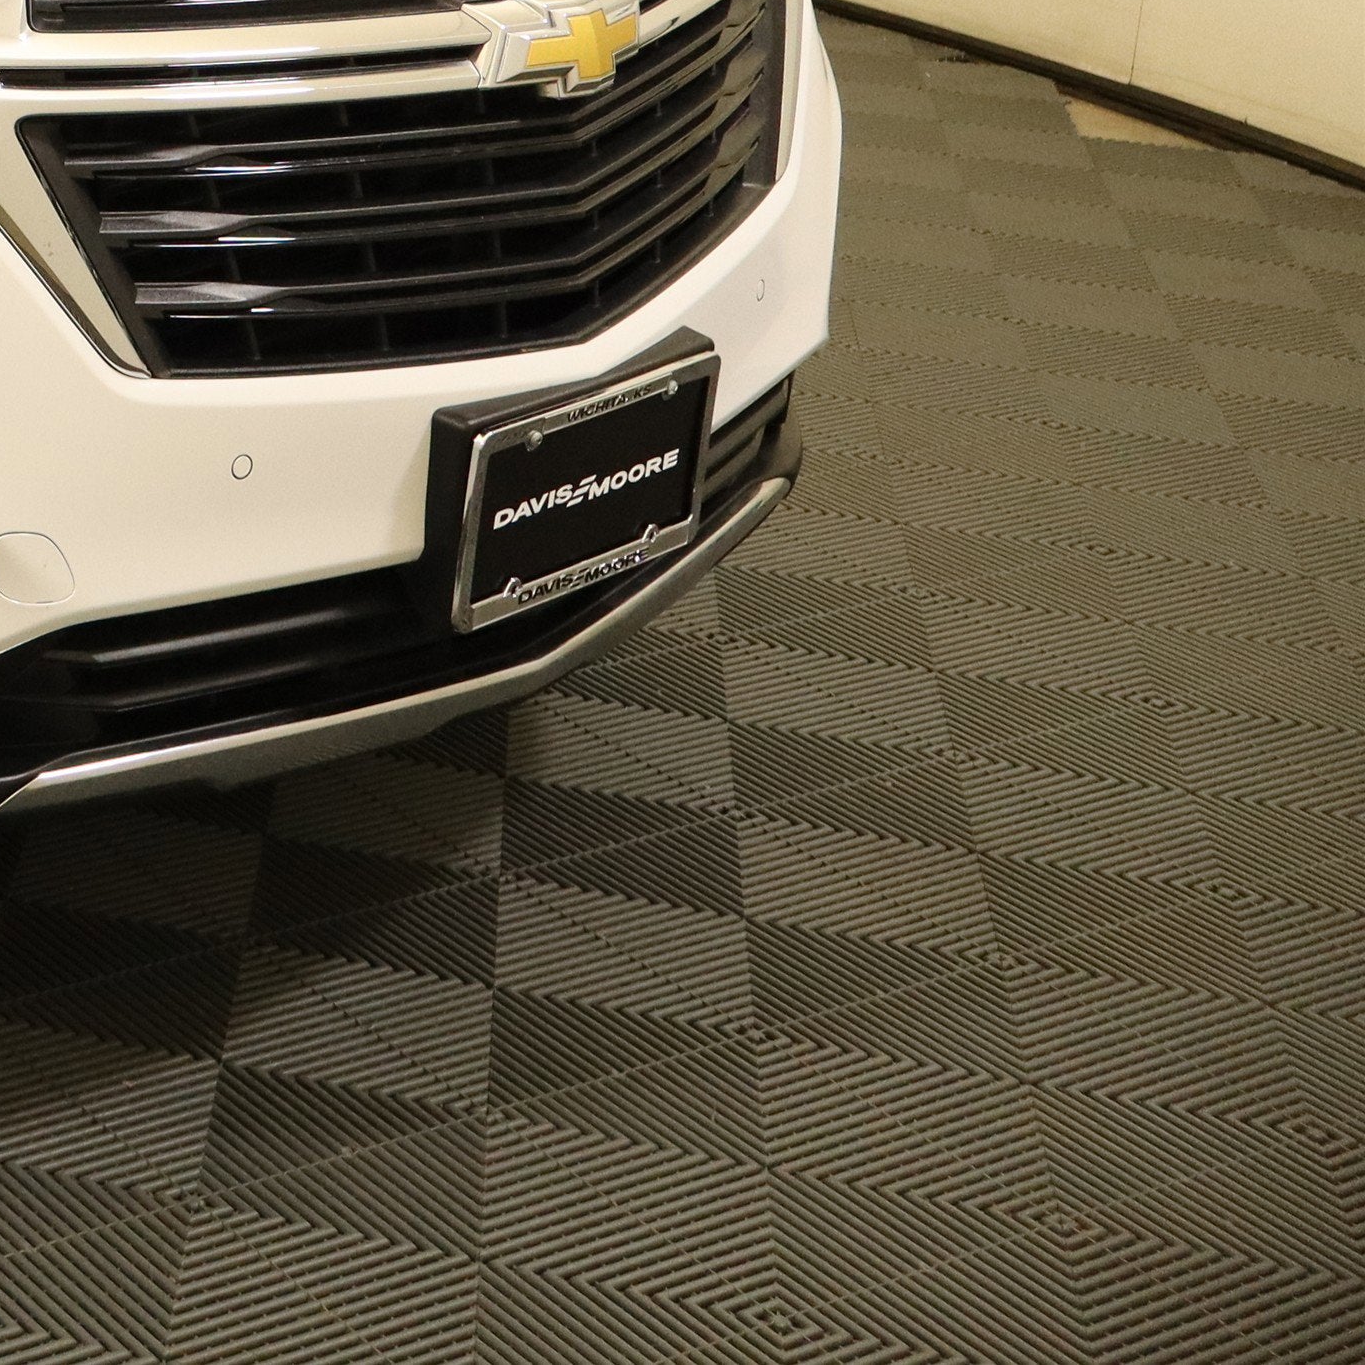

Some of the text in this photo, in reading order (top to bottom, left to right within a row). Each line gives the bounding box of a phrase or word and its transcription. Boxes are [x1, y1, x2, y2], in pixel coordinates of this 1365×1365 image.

[493, 447, 680, 531] DAVIS MOORE
[517, 546, 650, 605] DAVIS MOORE
